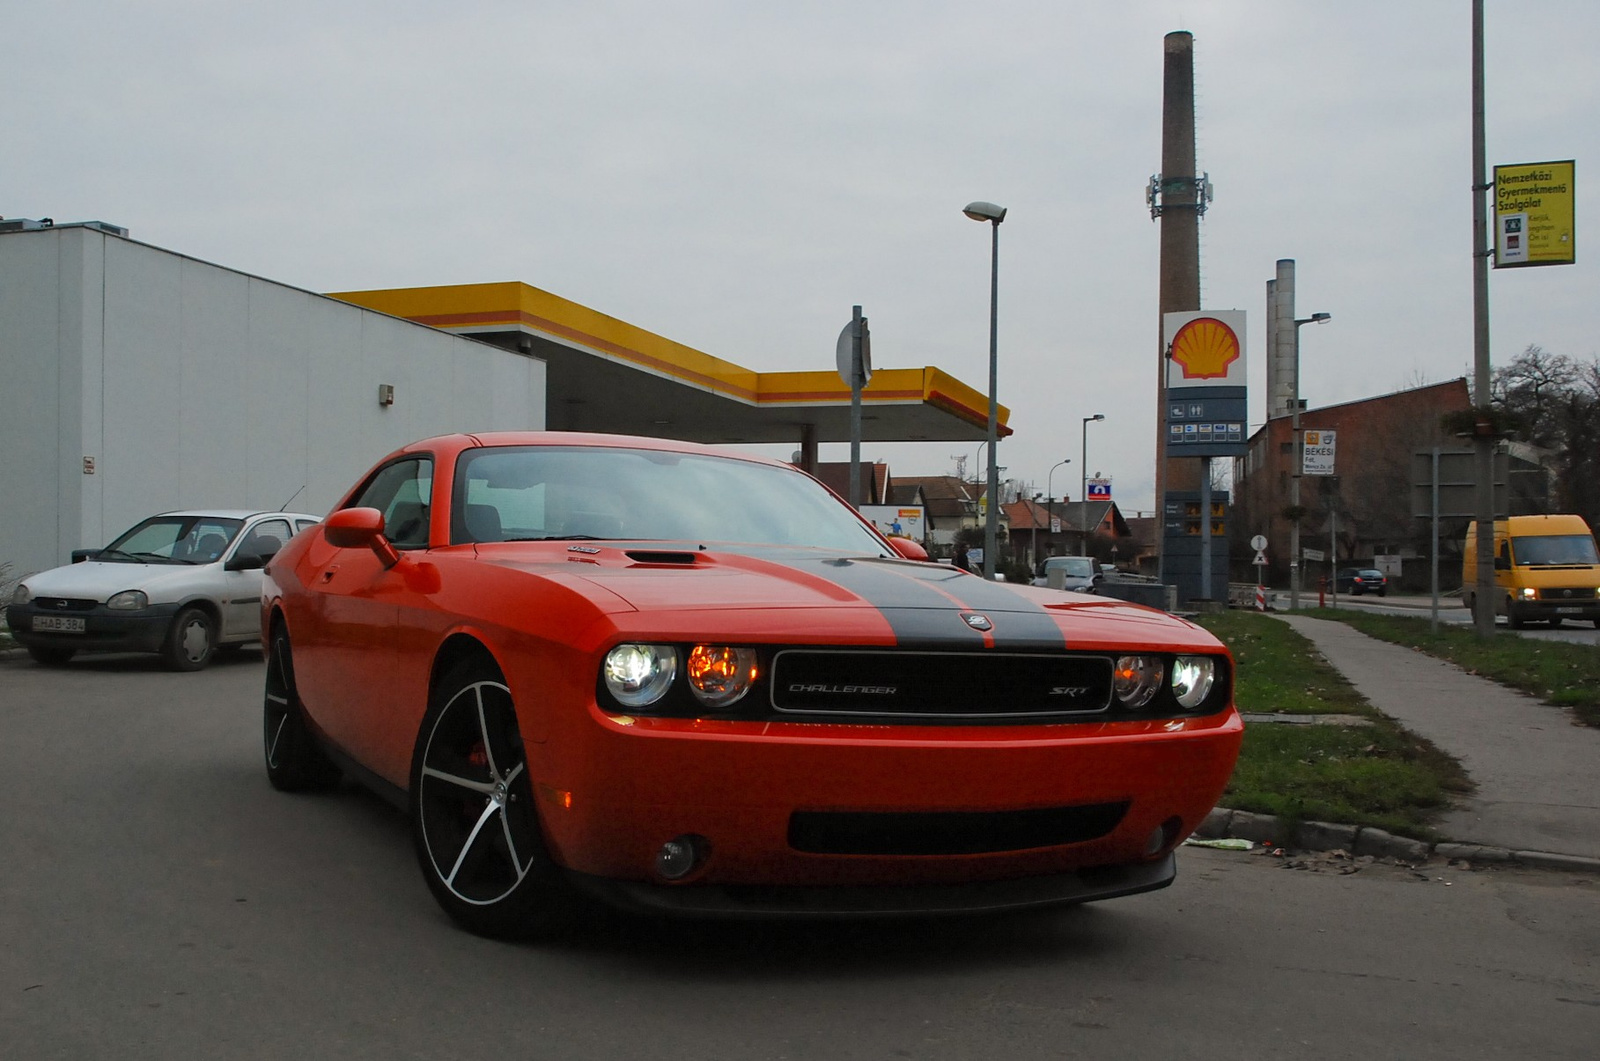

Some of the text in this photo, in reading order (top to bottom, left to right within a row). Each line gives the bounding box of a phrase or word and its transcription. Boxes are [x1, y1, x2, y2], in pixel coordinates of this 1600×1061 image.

[1498, 183, 1567, 199] Gyermekmentő
[1498, 197, 1542, 211] Szolgálat
[41, 618, 83, 630] HAB-384
[789, 684, 897, 694] CHALLENGER
[1049, 687, 1089, 697] SRT
